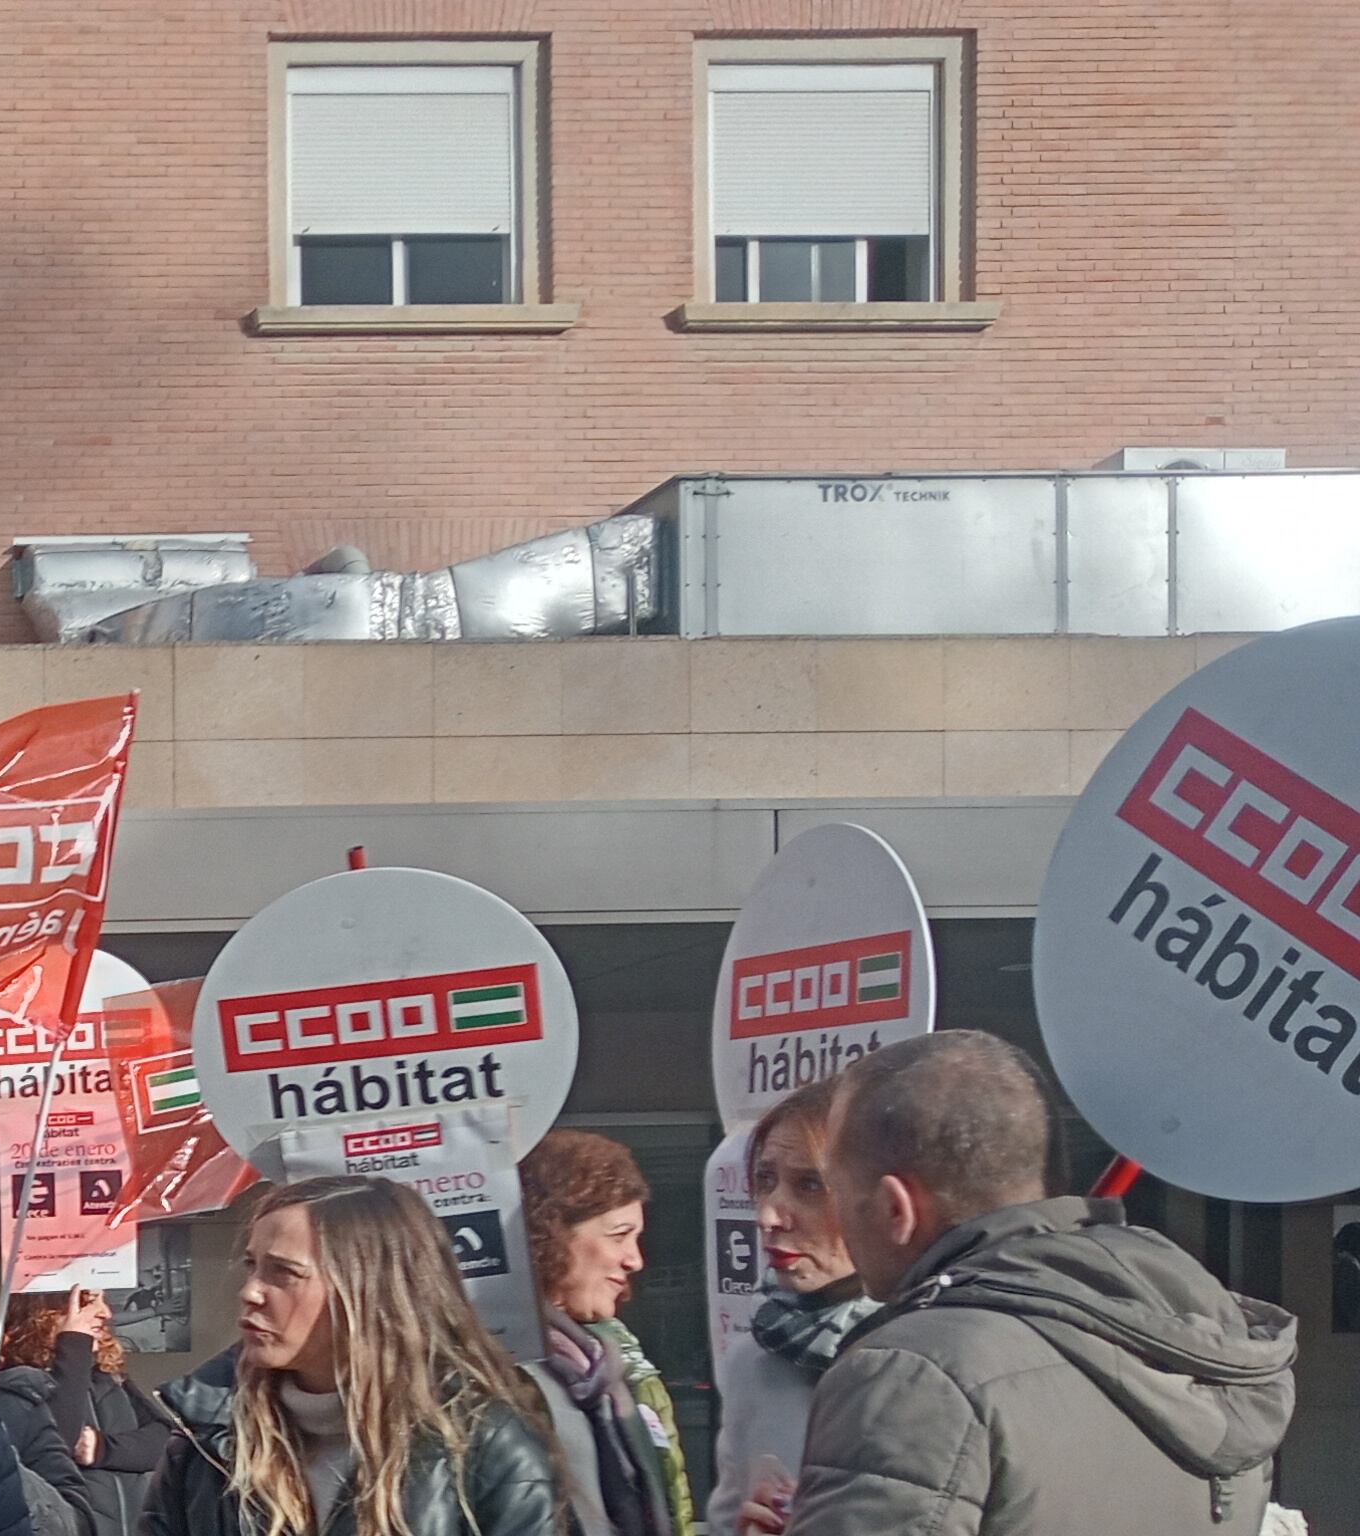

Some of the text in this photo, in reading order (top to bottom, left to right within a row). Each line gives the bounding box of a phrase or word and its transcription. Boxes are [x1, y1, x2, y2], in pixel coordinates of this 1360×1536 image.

[894, 491, 951, 502] TECHNIK
[1108, 852, 1360, 1096] hábita
[739, 960, 850, 1021] CCOO
[233, 994, 438, 1055] CCOO
[268, 1052, 505, 1119] hábitat
[49, 1115, 76, 1125] COO
[45, 1128, 80, 1138] ábitat
[347, 1131, 411, 1152] CCOO
[39, 1140, 57, 1158] de
[65, 1143, 116, 1157] enero
[345, 1153, 421, 1174] hábitat
[415, 1172, 485, 1194] nero
[716, 1167, 737, 1193] 20
